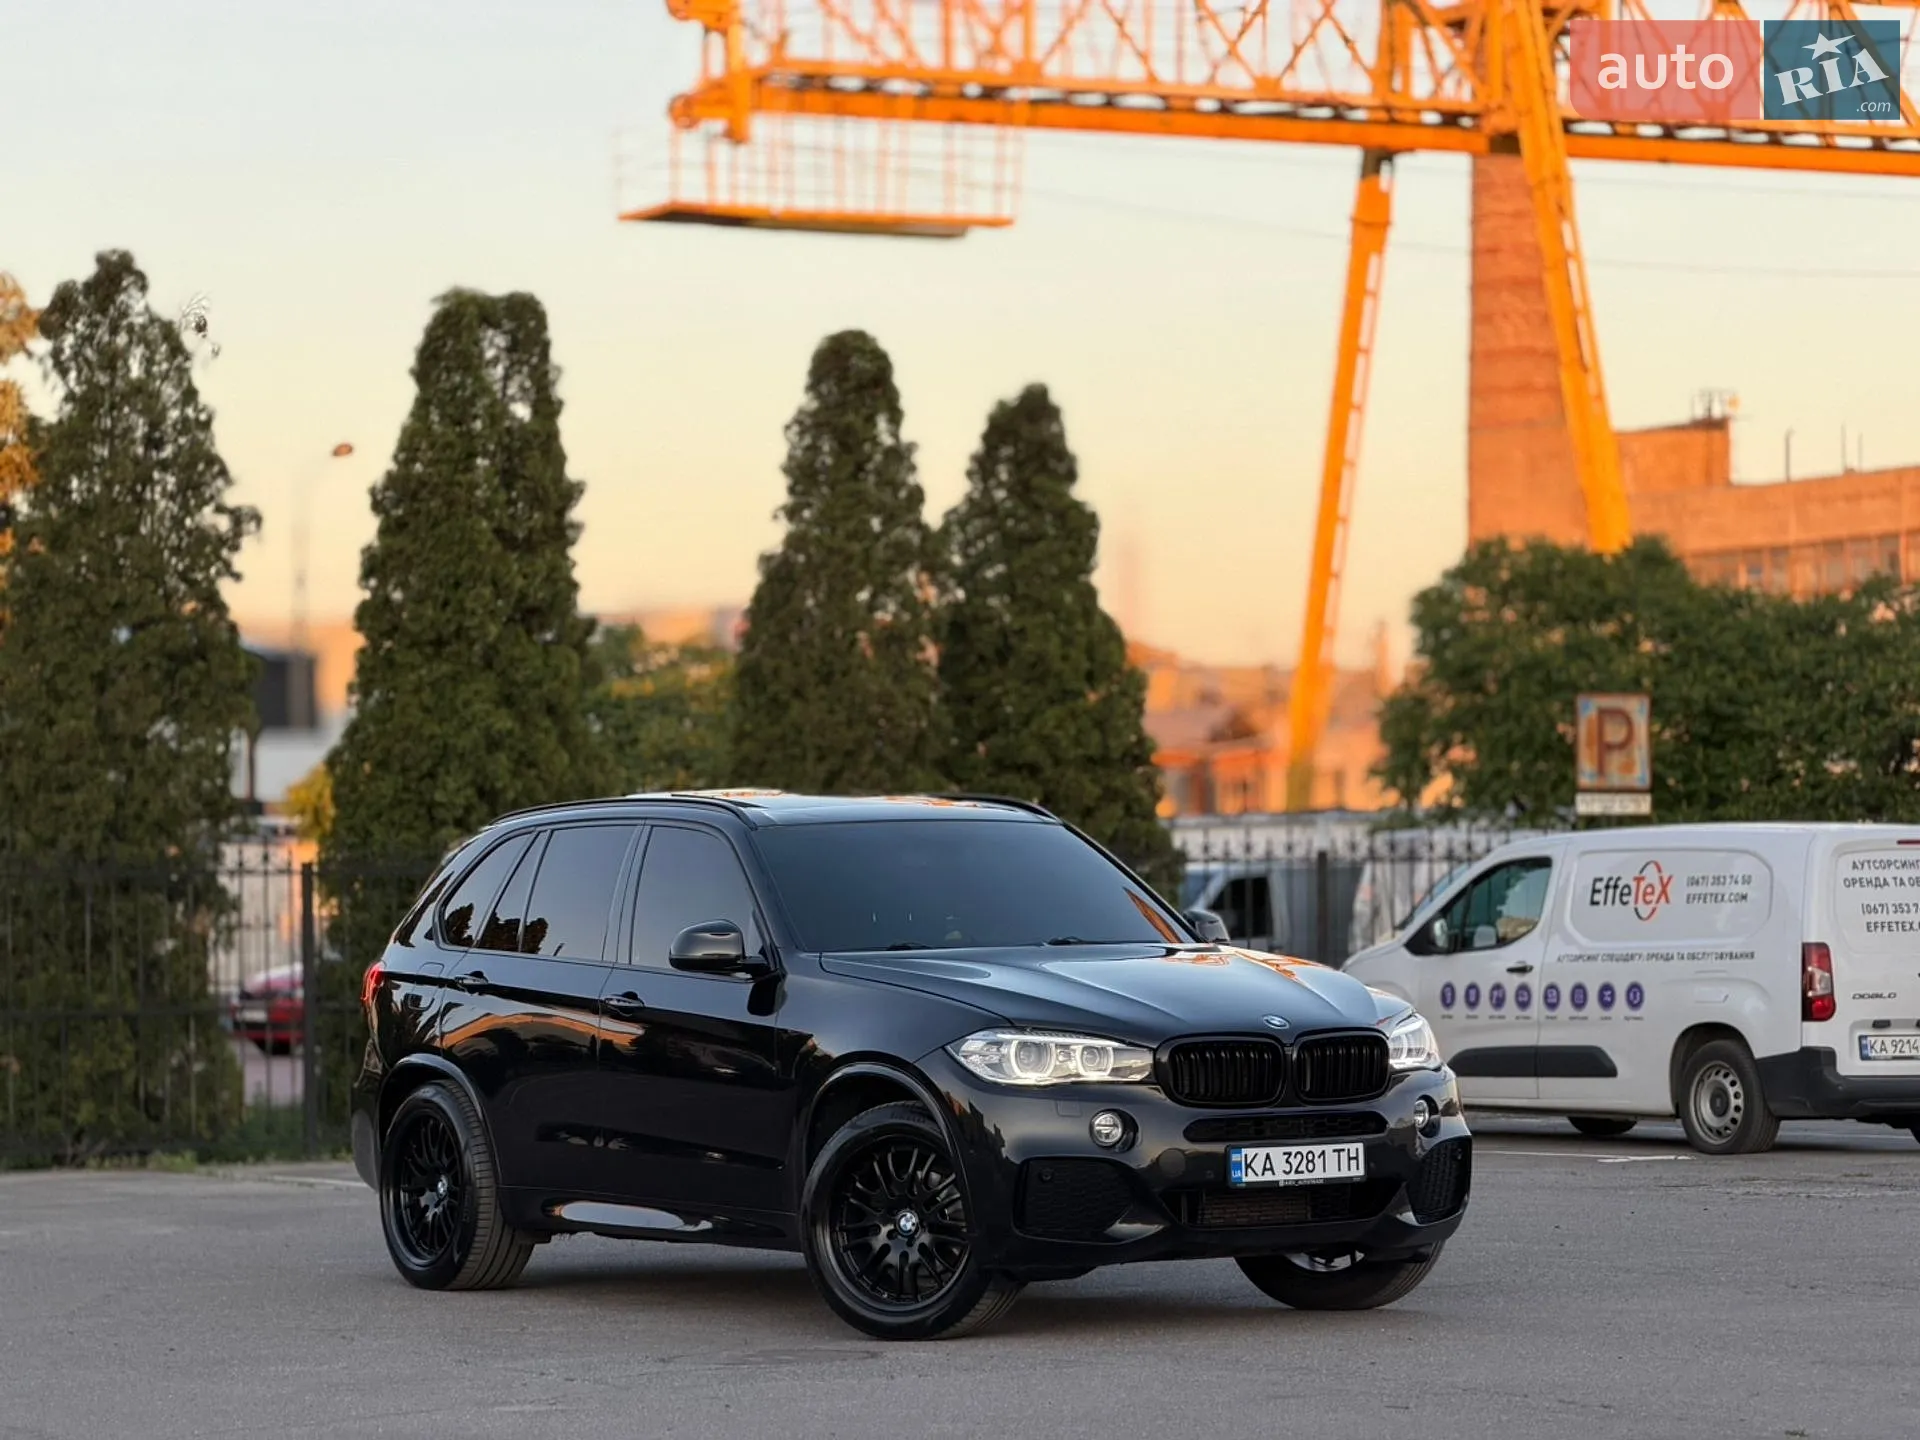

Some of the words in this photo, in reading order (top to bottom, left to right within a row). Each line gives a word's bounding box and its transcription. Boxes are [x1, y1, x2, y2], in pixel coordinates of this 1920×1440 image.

[1597, 708, 1634, 776] P
[1843, 877, 1889, 890] ОРЕНДА
[1892, 876, 1906, 888] ТА
[1590, 875, 1673, 906] EffeTeX
[1686, 892, 1749, 904] EFFETEX.COM
[1861, 902, 1889, 915] (067)
[1892, 902, 1911, 915] 353
[1866, 920, 1920, 933] EFFETEX.
[1869, 1039, 1888, 1054] KA
[1244, 1152, 1275, 1178] KA
[1282, 1150, 1327, 1176] 3281
[1333, 1148, 1360, 1172] TH
